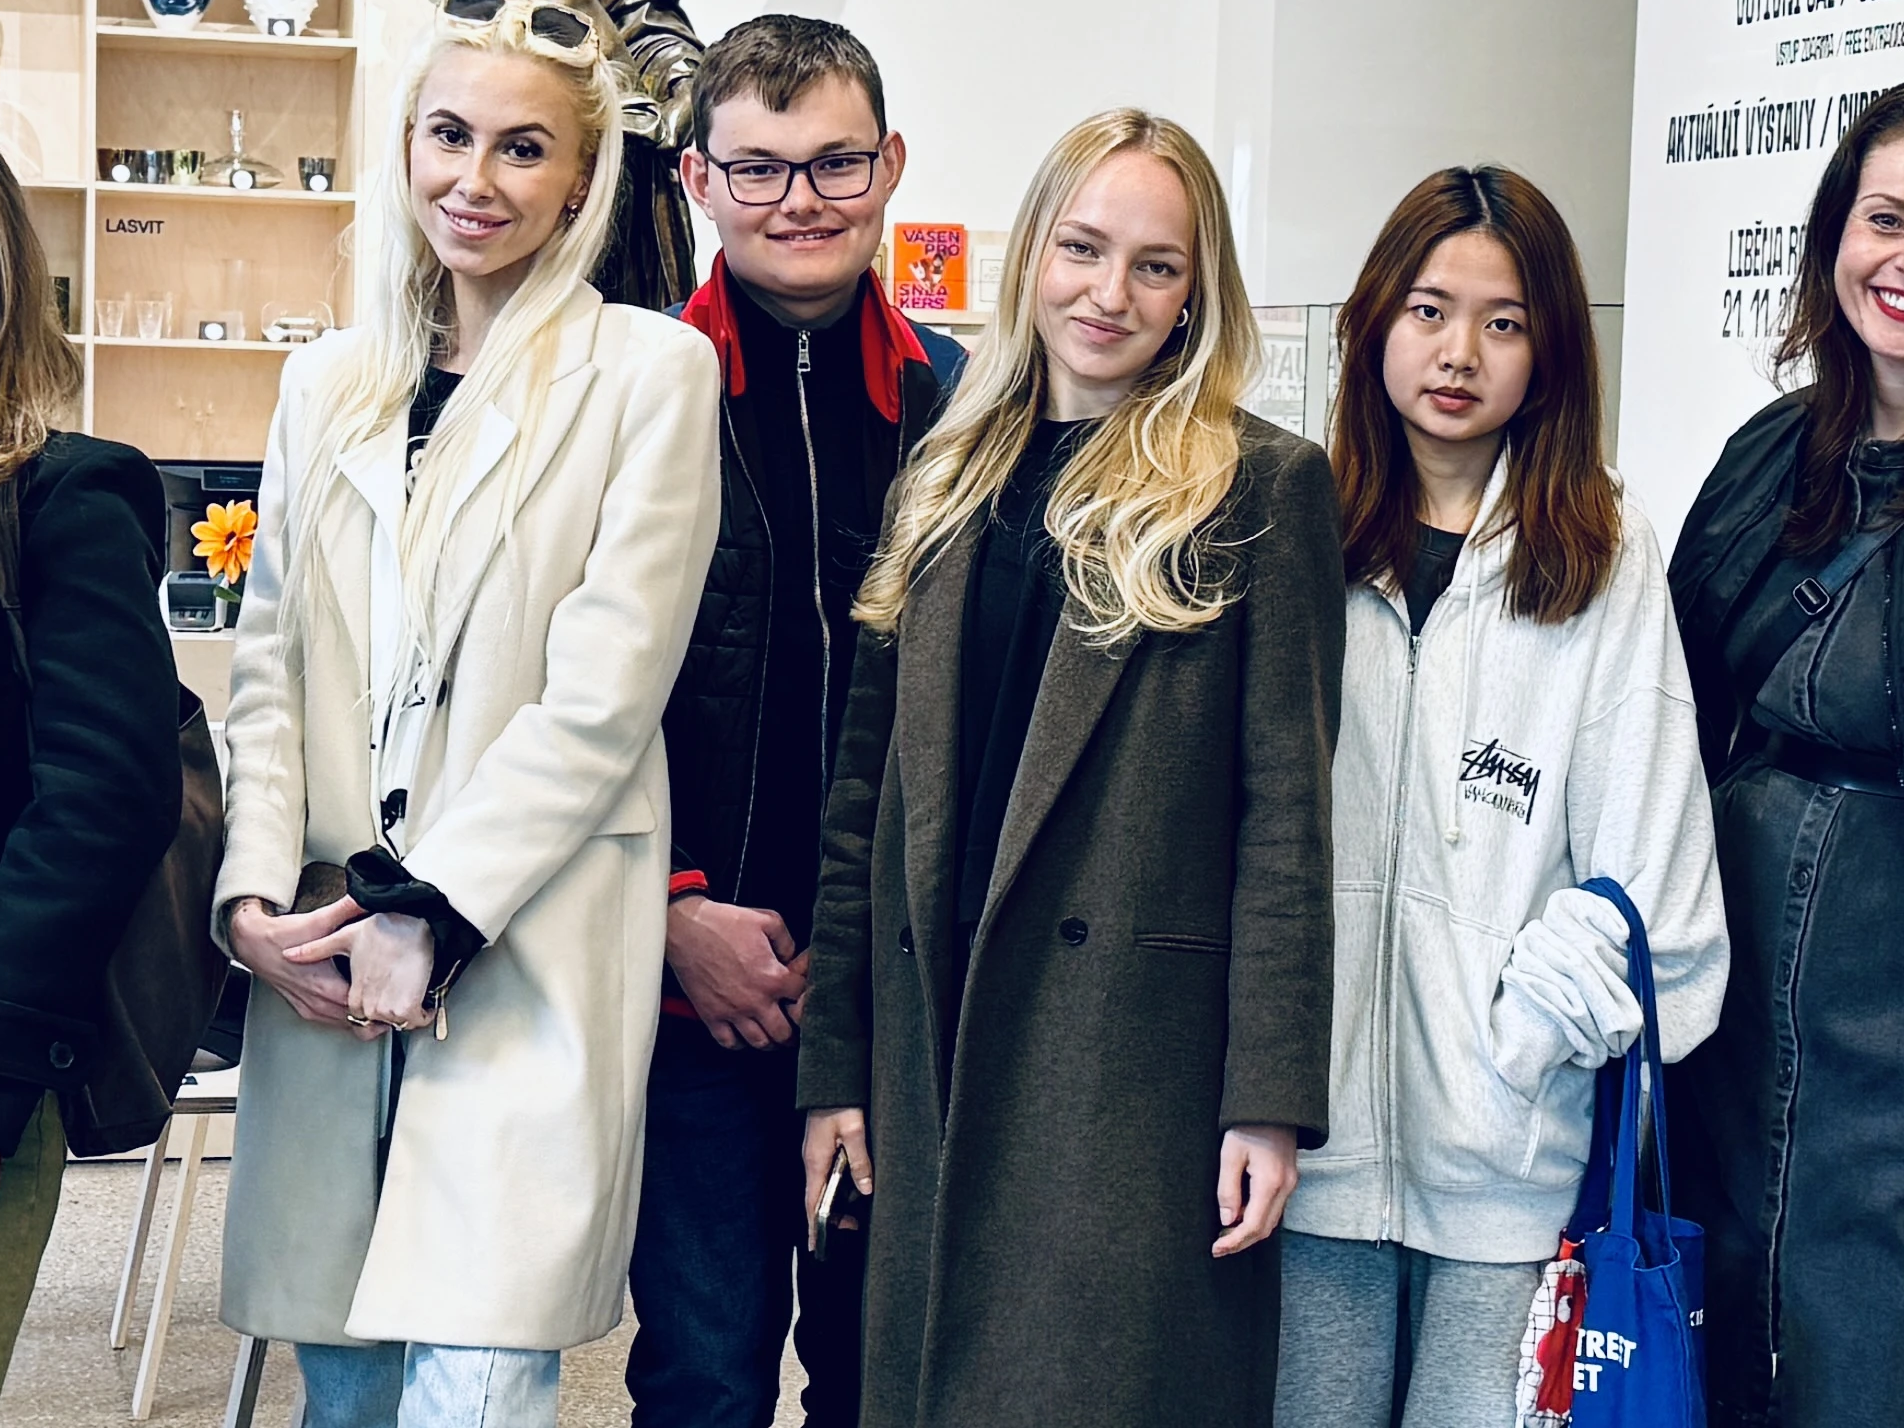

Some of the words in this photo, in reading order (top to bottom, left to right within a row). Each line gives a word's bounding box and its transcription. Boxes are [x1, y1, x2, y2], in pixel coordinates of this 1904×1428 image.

[1666, 100, 1741, 164] AKTUÁLNÍ
[1744, 96, 1816, 155] VÝSTAVY
[1820, 96, 1833, 148] /
[106, 218, 165, 234] LASVIT
[924, 244, 960, 257] PRO
[1728, 220, 1783, 277] LIBĚNA
